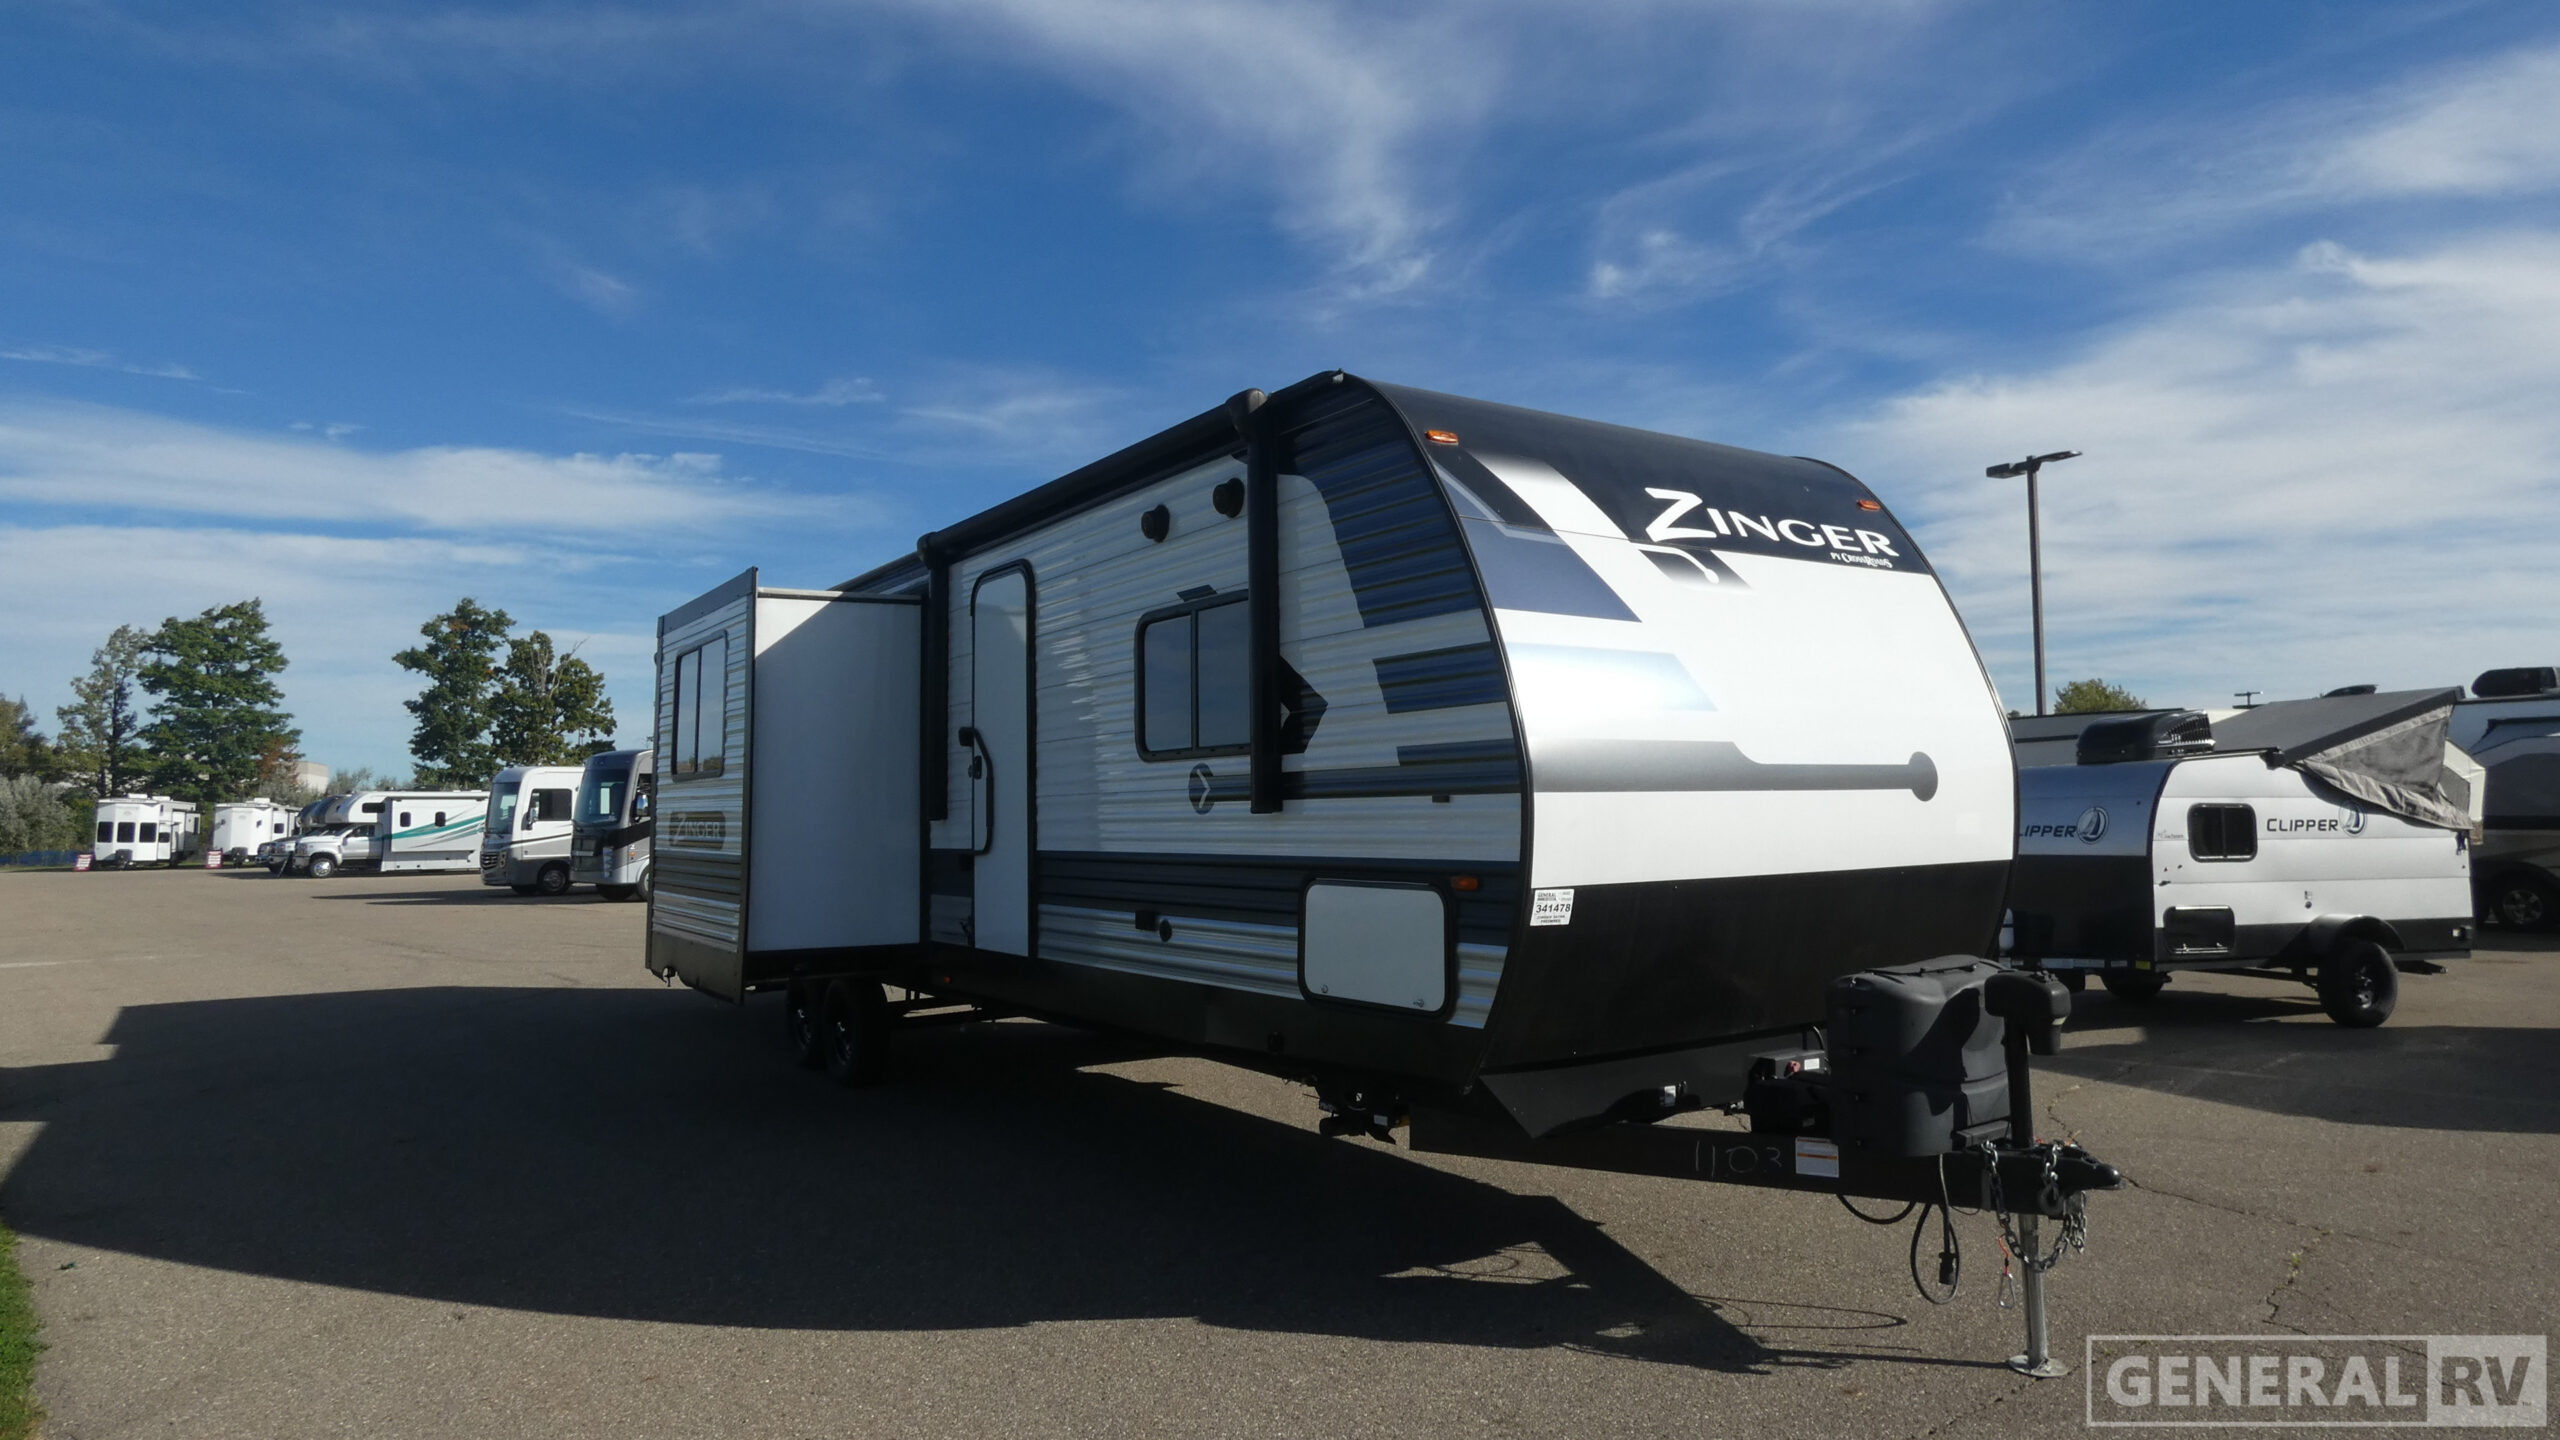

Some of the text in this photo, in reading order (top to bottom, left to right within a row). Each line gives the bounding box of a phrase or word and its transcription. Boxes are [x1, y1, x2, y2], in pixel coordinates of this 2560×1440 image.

[1645, 487, 1899, 557] ZINGER
[671, 813, 721, 846] ZINGER
[2019, 825, 2078, 838] IPPER
[2267, 818, 2339, 832] CLIPPER
[1536, 903, 1571, 914] 341478
